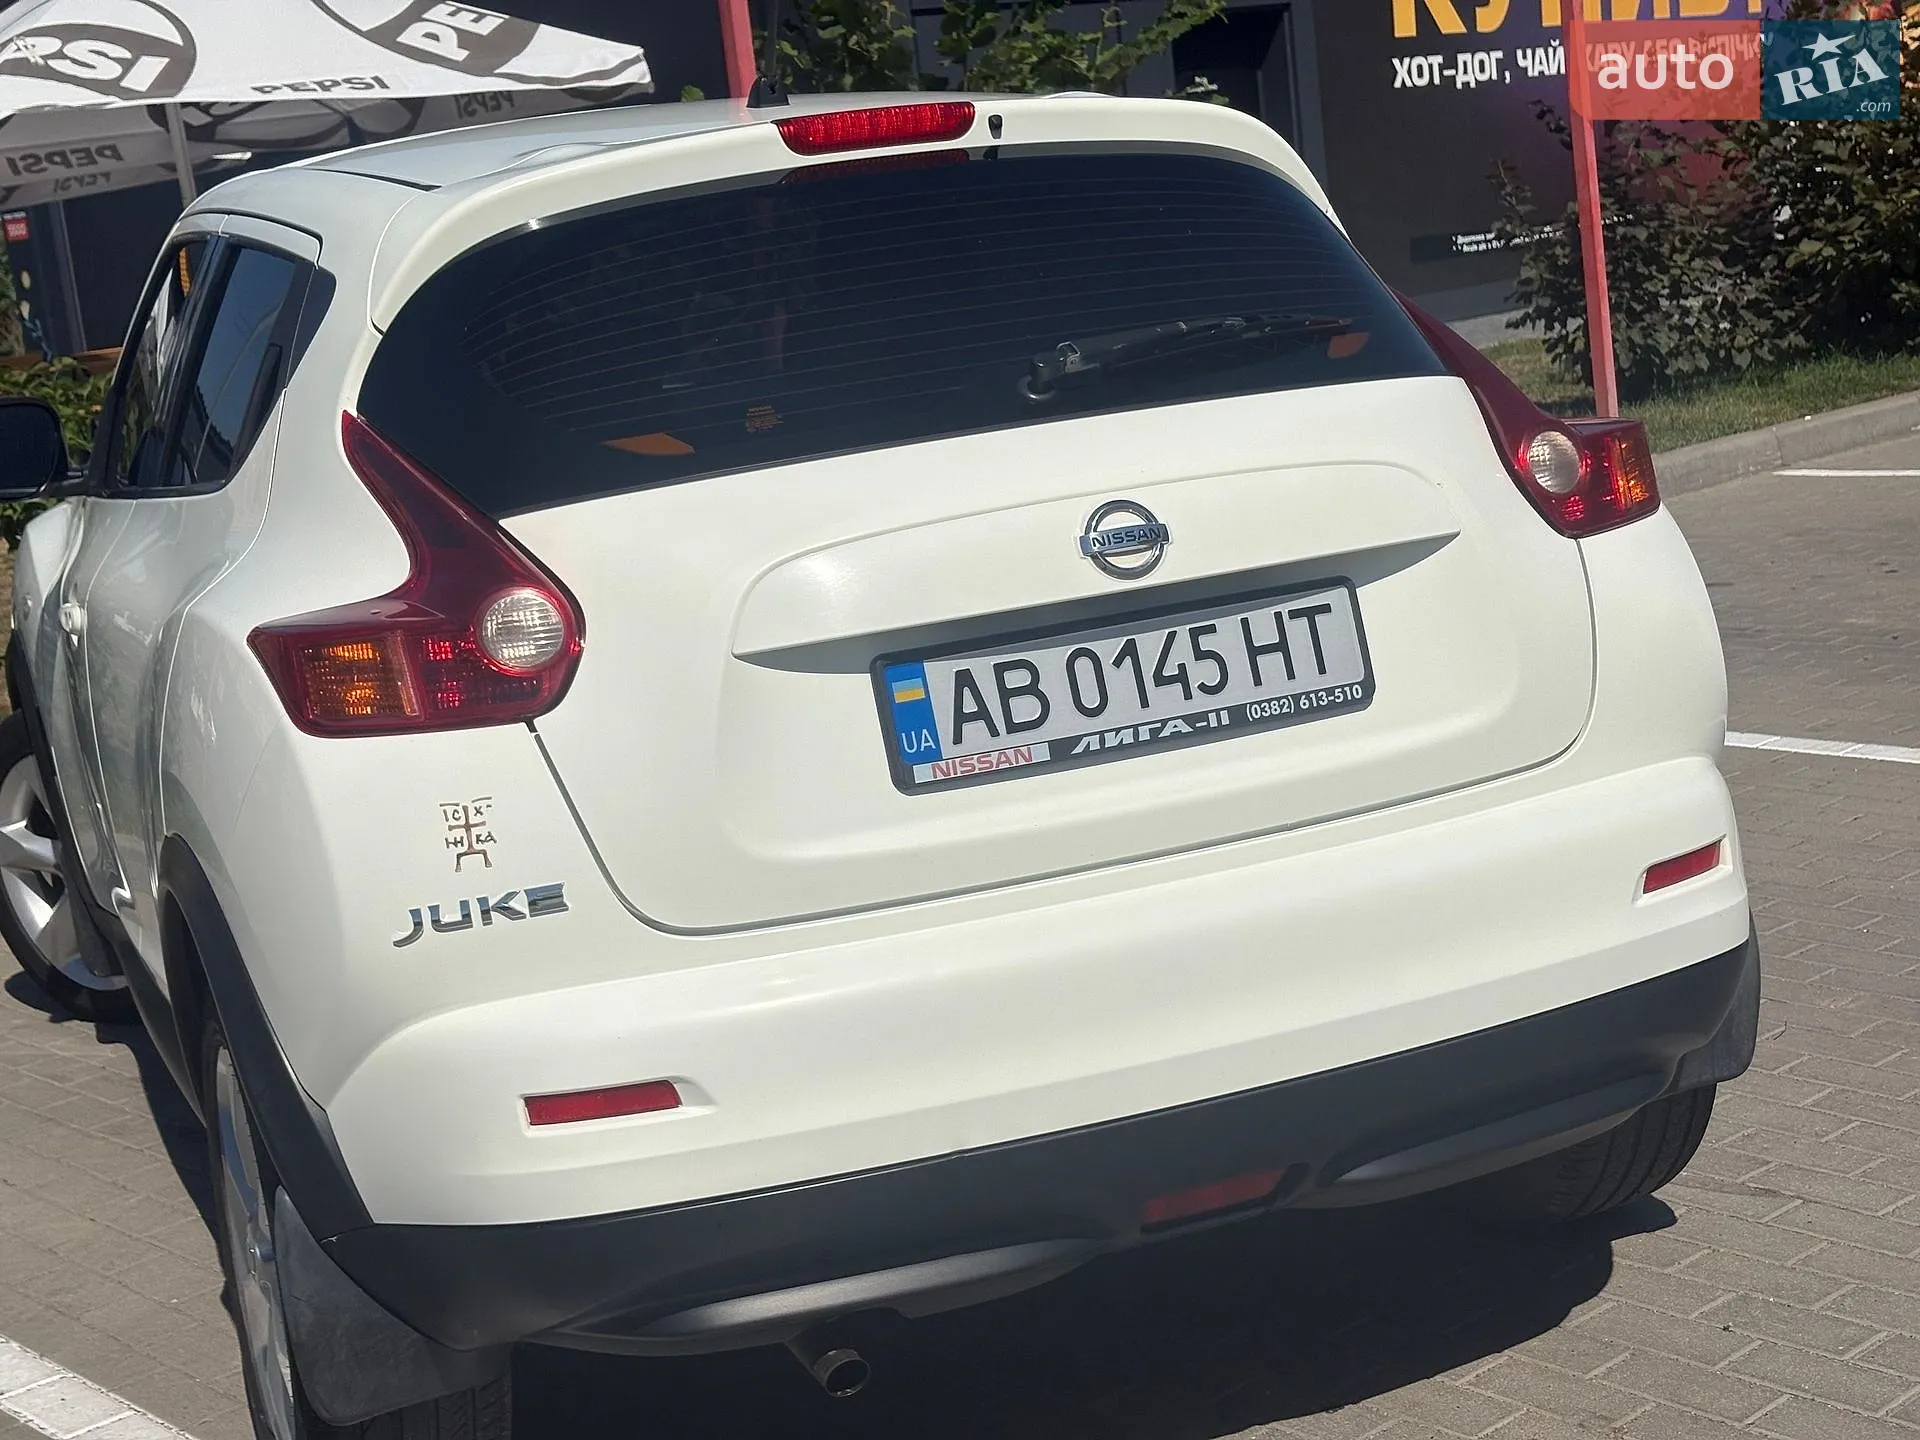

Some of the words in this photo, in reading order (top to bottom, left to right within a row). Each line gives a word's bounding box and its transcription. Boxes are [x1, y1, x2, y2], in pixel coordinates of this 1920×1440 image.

[1392, 50, 1511, 90] ХОТ-ДОГ,
[1516, 39, 1566, 77] ЧАЙ
[251, 75, 391, 95] PEPSI
[1091, 527, 1162, 548] NISSAN
[952, 657, 1051, 746] AB
[1066, 623, 1229, 718] 0145
[1241, 602, 1332, 687] HT
[1246, 695, 1295, 722] (0382)
[1299, 684, 1363, 710] 613-510
[902, 728, 936, 753] UA
[931, 747, 1033, 779] NISSAN
[393, 881, 569, 948] JUKE
